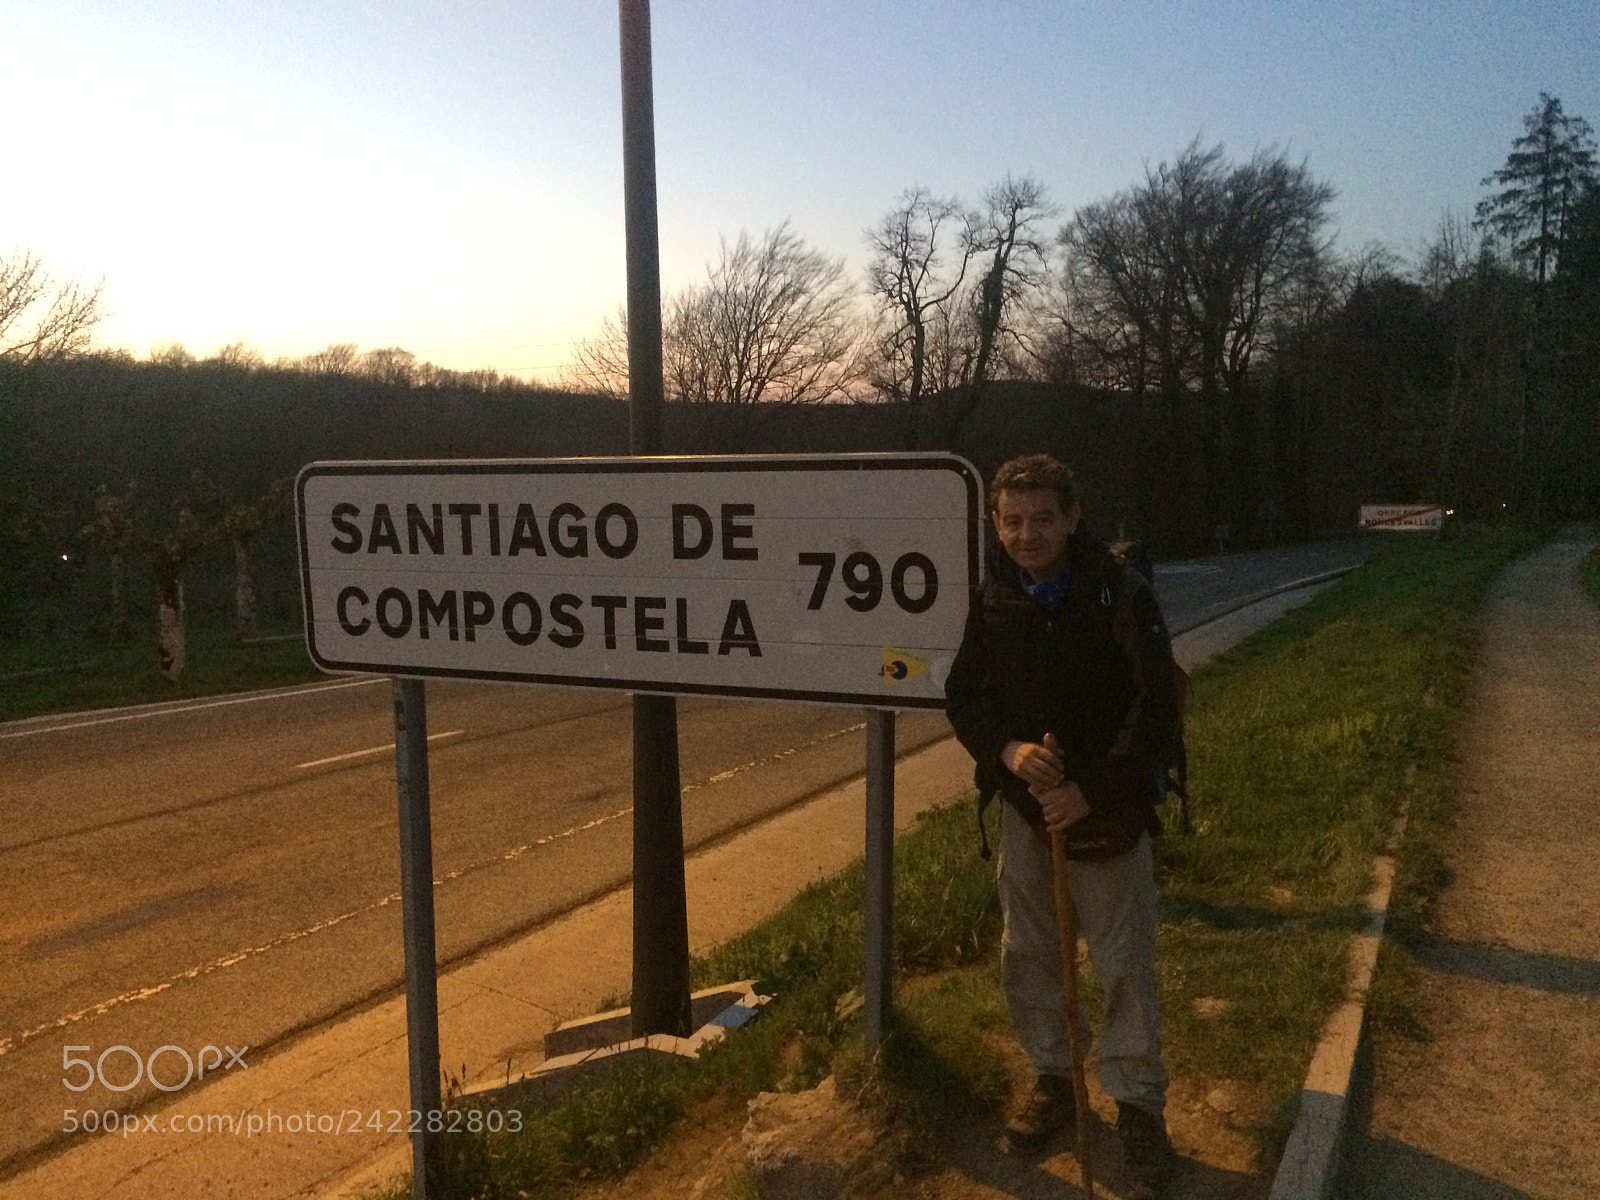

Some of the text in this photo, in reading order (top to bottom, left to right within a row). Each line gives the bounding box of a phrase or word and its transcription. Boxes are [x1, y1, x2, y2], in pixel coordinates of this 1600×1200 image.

[330, 501, 759, 561] SANTIAGO DE
[798, 551, 939, 614] 790
[336, 585, 763, 658] COMPOSTELA
